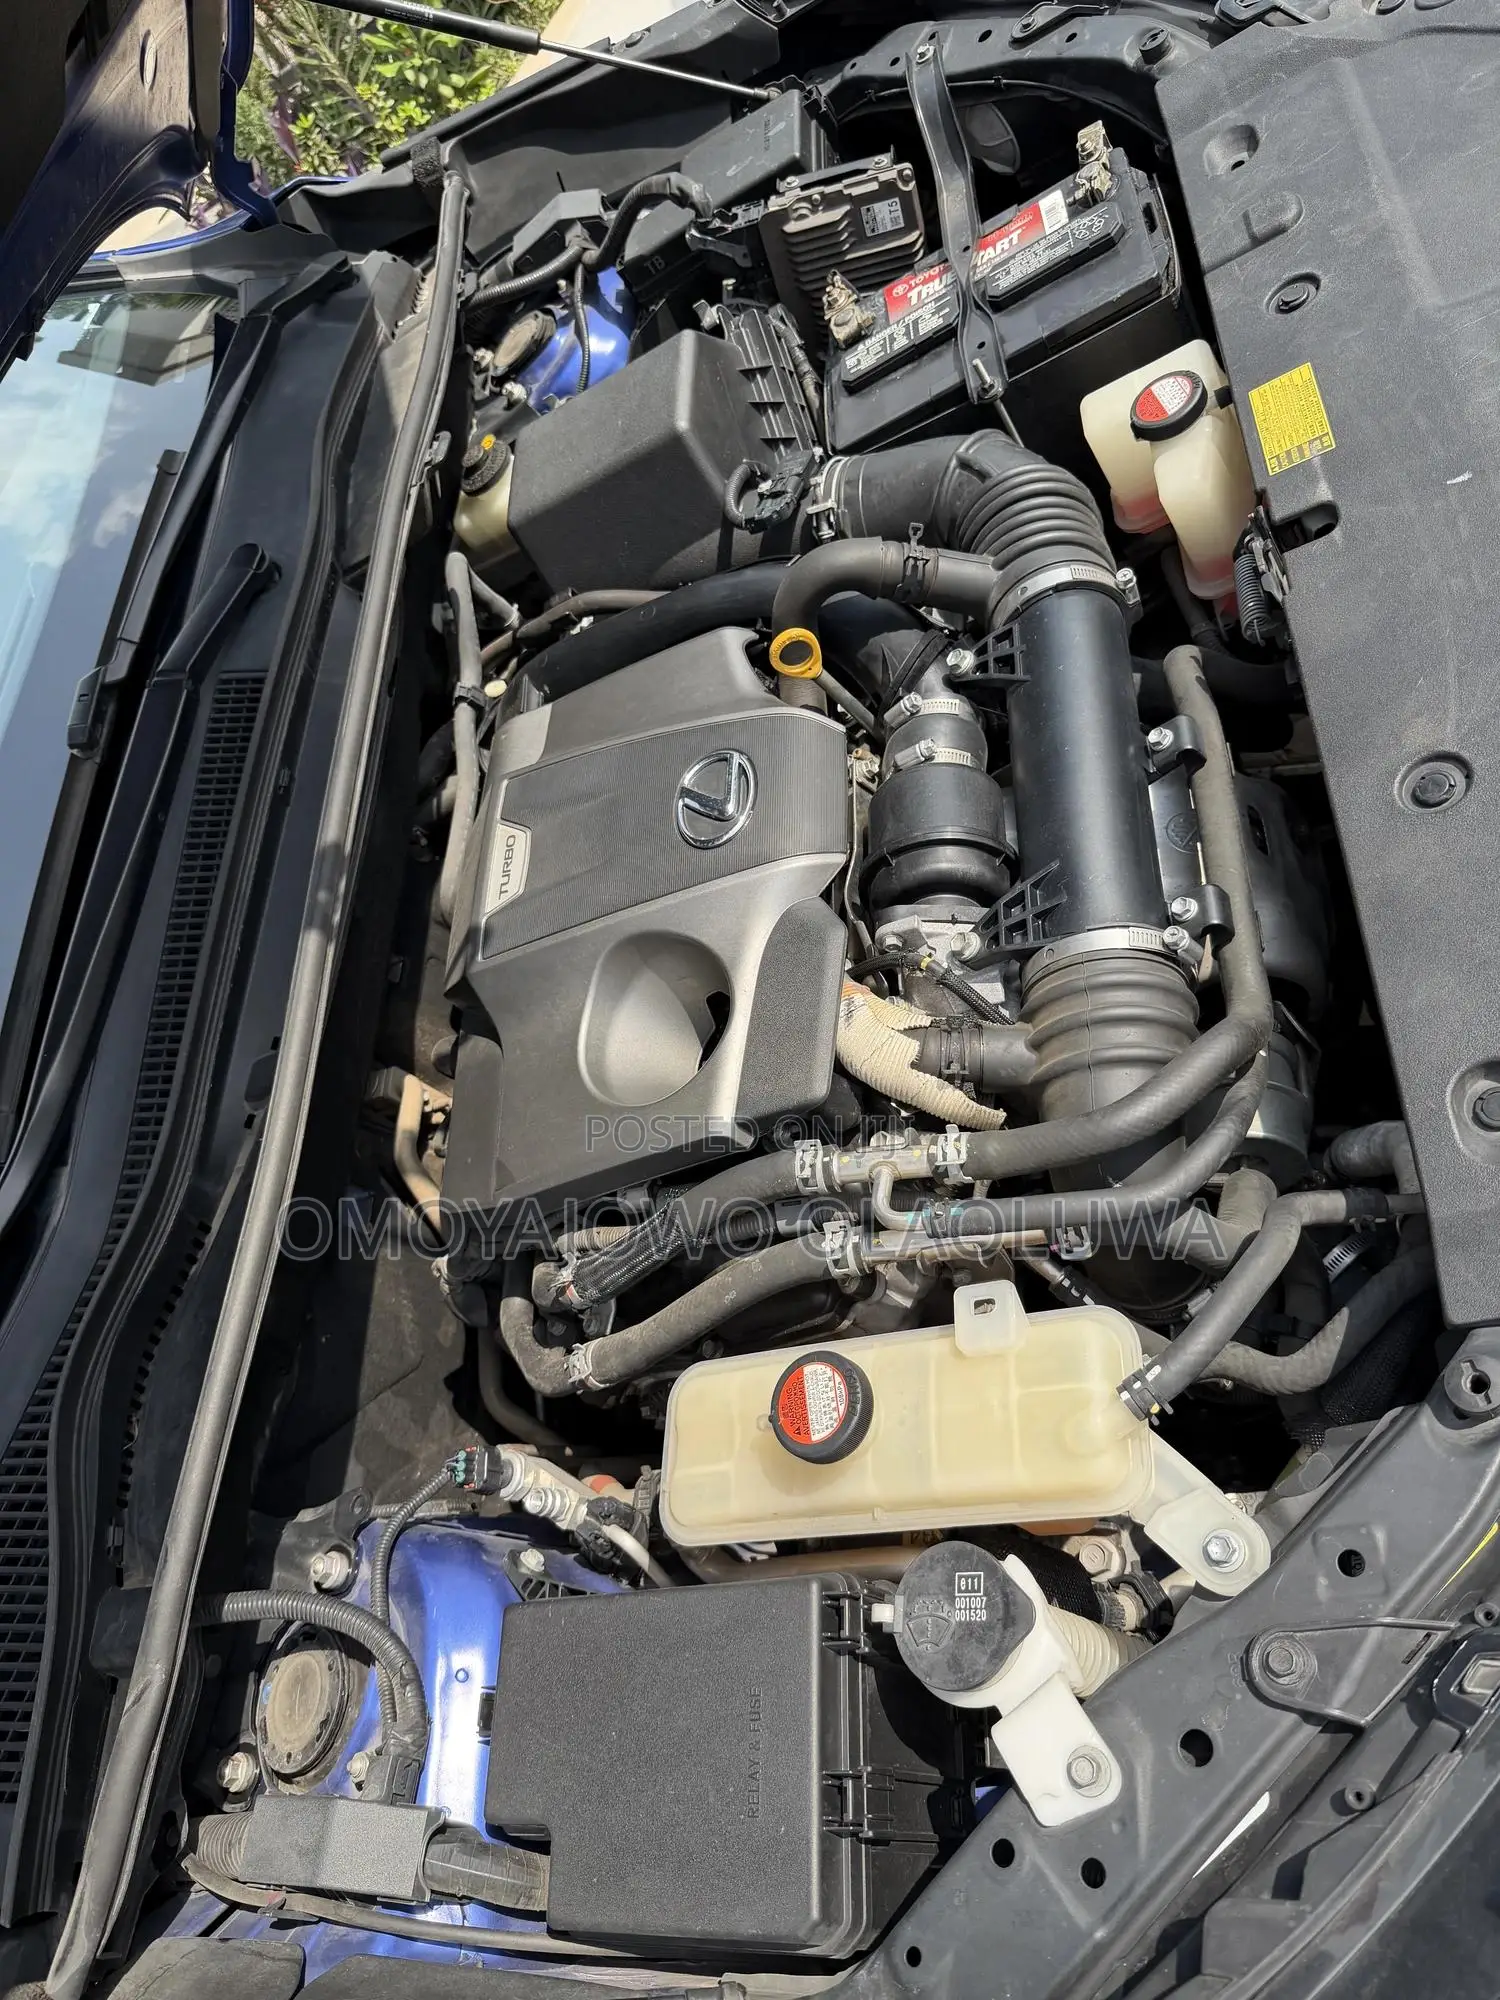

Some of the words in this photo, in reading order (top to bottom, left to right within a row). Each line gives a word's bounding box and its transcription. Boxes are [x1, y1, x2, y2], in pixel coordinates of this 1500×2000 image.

[907, 269, 958, 306] TRUE
[498, 834, 517, 901] TURBO
[785, 1387, 796, 1427] WARNING
[796, 1376, 811, 1436] AVERTISSEMENT
[955, 1597, 987, 1609] 001007
[955, 1609, 987, 1621] 001520
[750, 1686, 763, 1734] FUSE
[748, 1739, 761, 1752] &
[747, 1757, 761, 1819] RELAY
